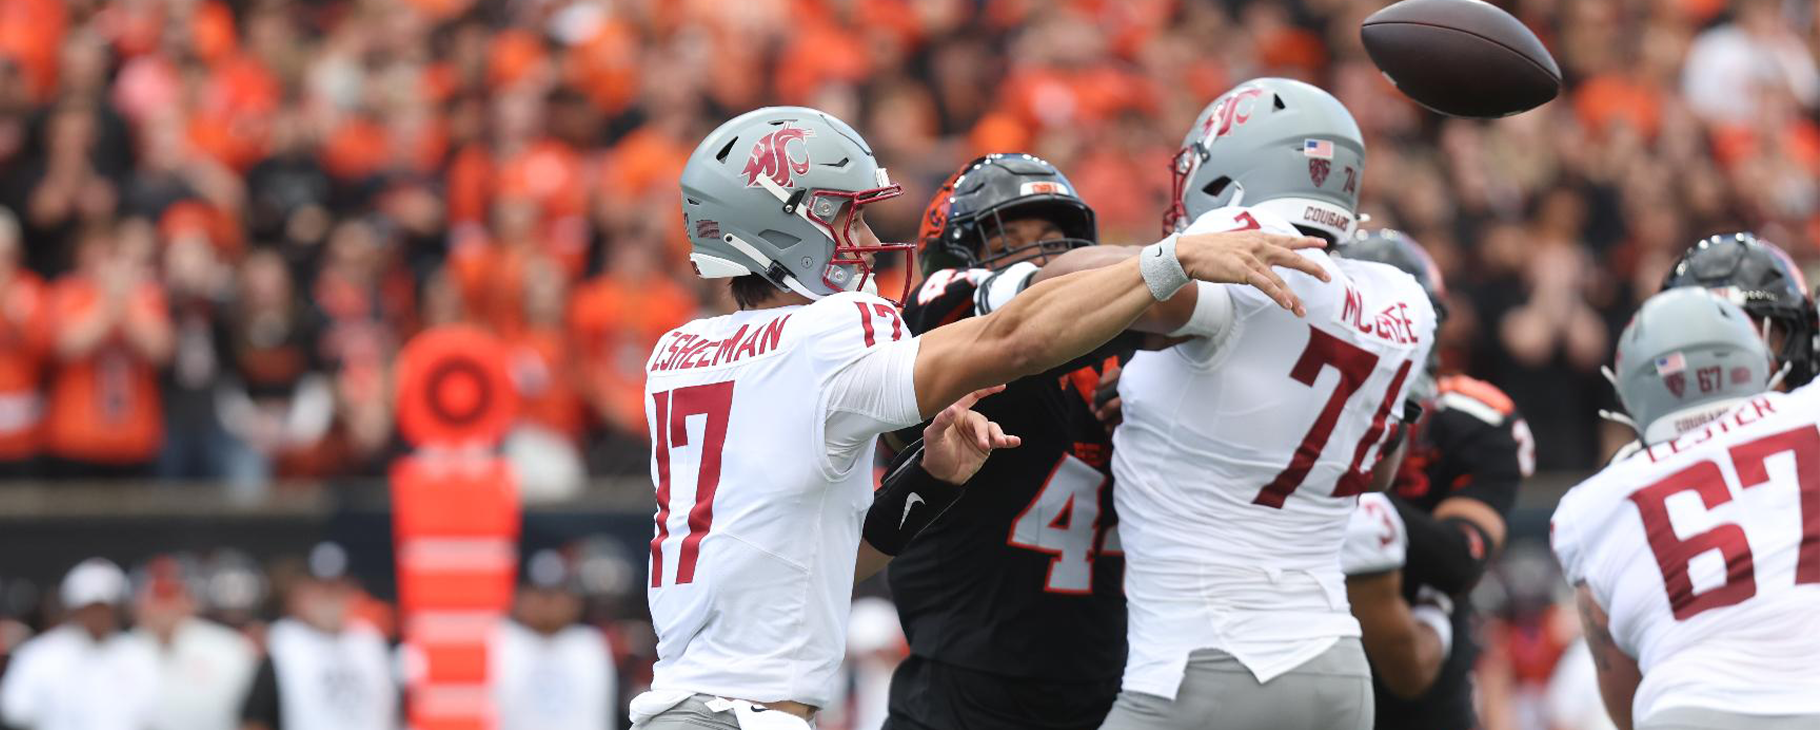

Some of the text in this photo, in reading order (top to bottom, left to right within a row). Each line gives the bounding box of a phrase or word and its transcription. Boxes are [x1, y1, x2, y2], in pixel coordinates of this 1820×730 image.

[853, 302, 901, 348] 17
[1697, 366, 1722, 394] 67
[651, 380, 735, 588] 17
[1006, 451, 1125, 594] 4
[1626, 424, 1820, 621] 67
